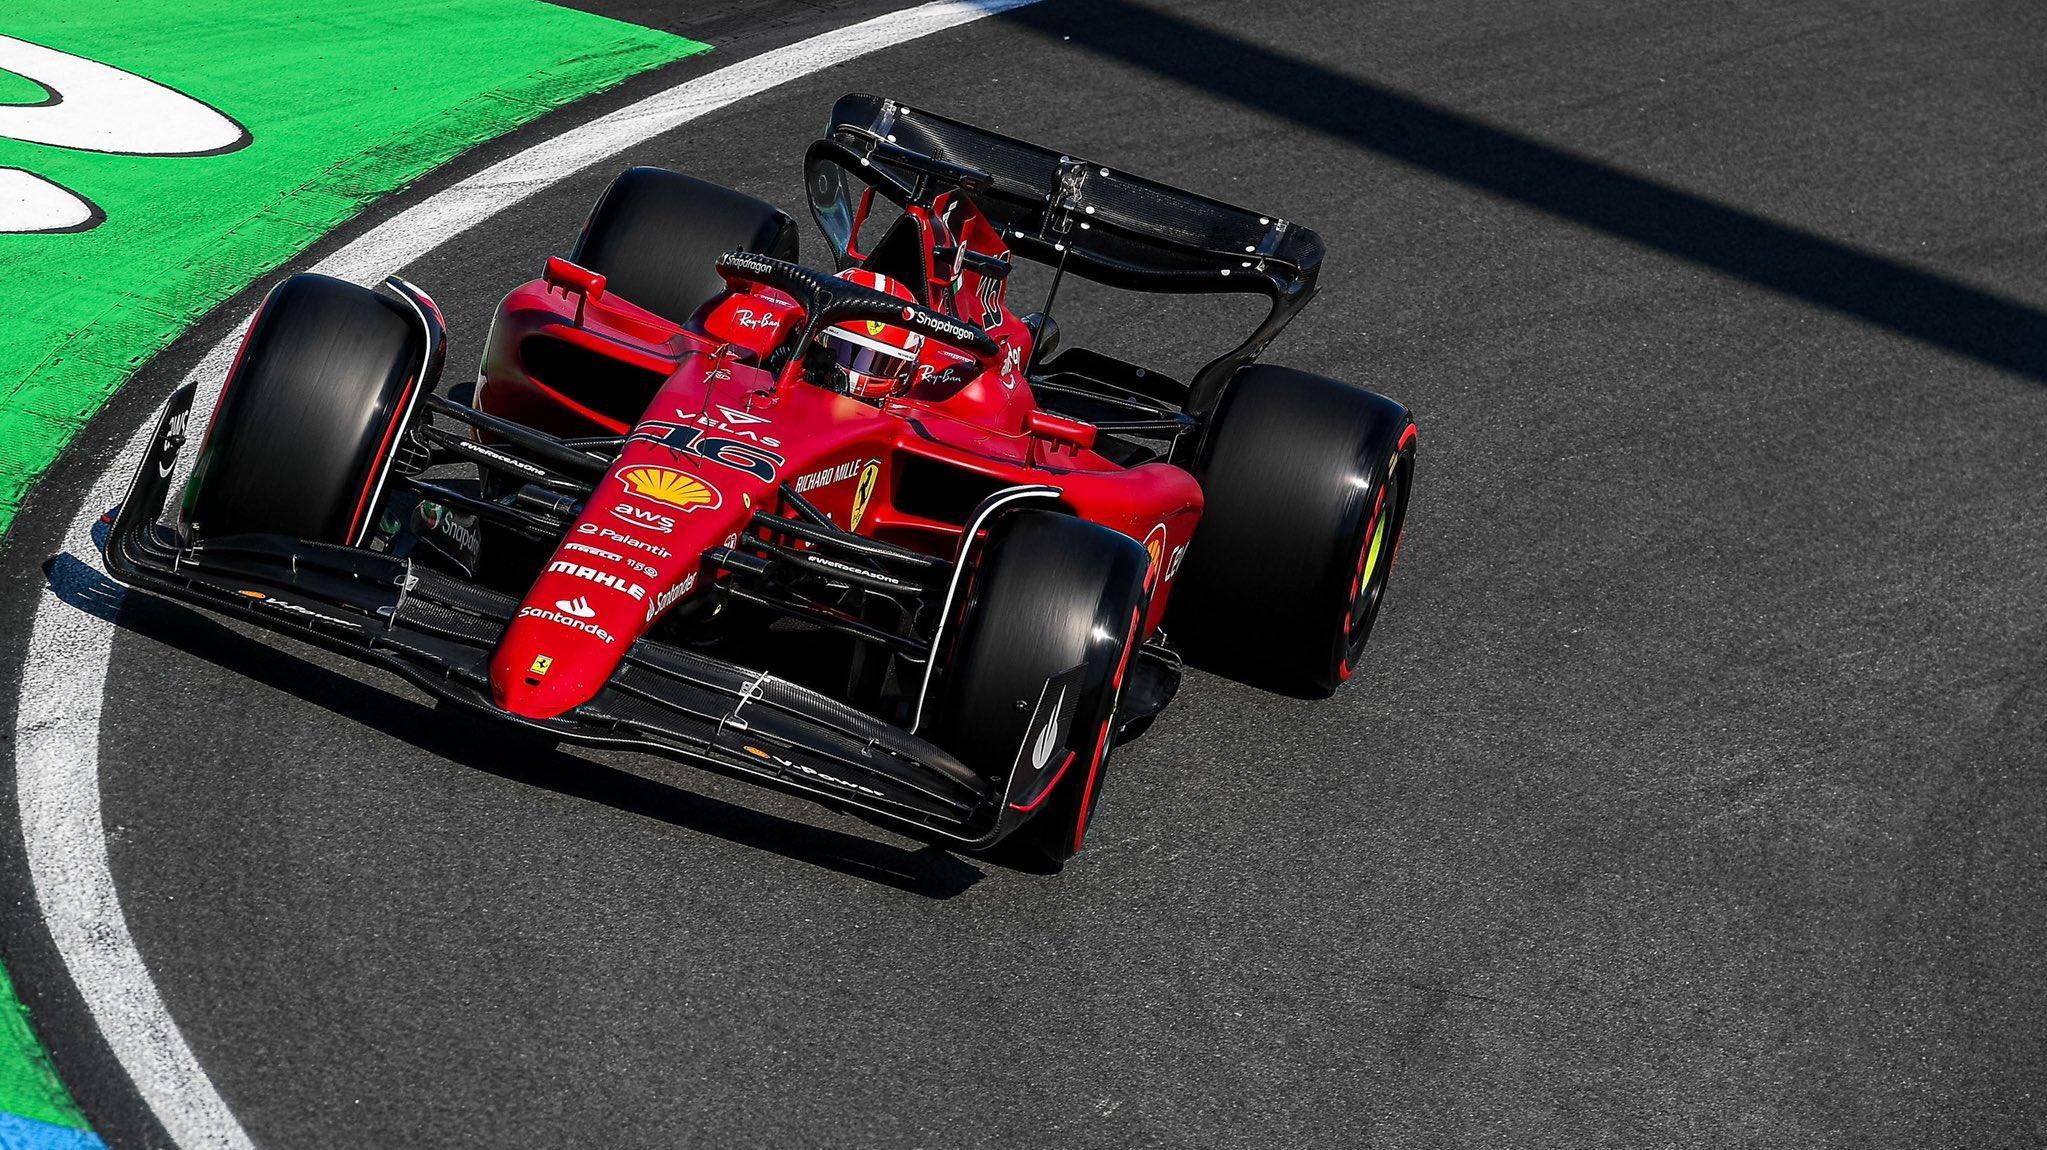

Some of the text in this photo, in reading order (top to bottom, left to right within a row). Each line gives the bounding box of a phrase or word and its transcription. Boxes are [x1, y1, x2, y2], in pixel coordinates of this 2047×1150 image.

[727, 255, 772, 274] Snapdragon
[916, 312, 975, 341] Snapdragon
[675, 408, 781, 447] VELAS
[459, 441, 546, 476] #WeRaceAsOne
[622, 419, 786, 484] 16
[795, 458, 862, 492] RICHARD MILLE
[614, 503, 676, 528] aws
[600, 528, 672, 559] Palantir
[548, 560, 646, 601] MAHLE
[807, 555, 899, 585] #WeRaceAsOne
[654, 571, 698, 616] Santander
[518, 606, 615, 644] Santander
